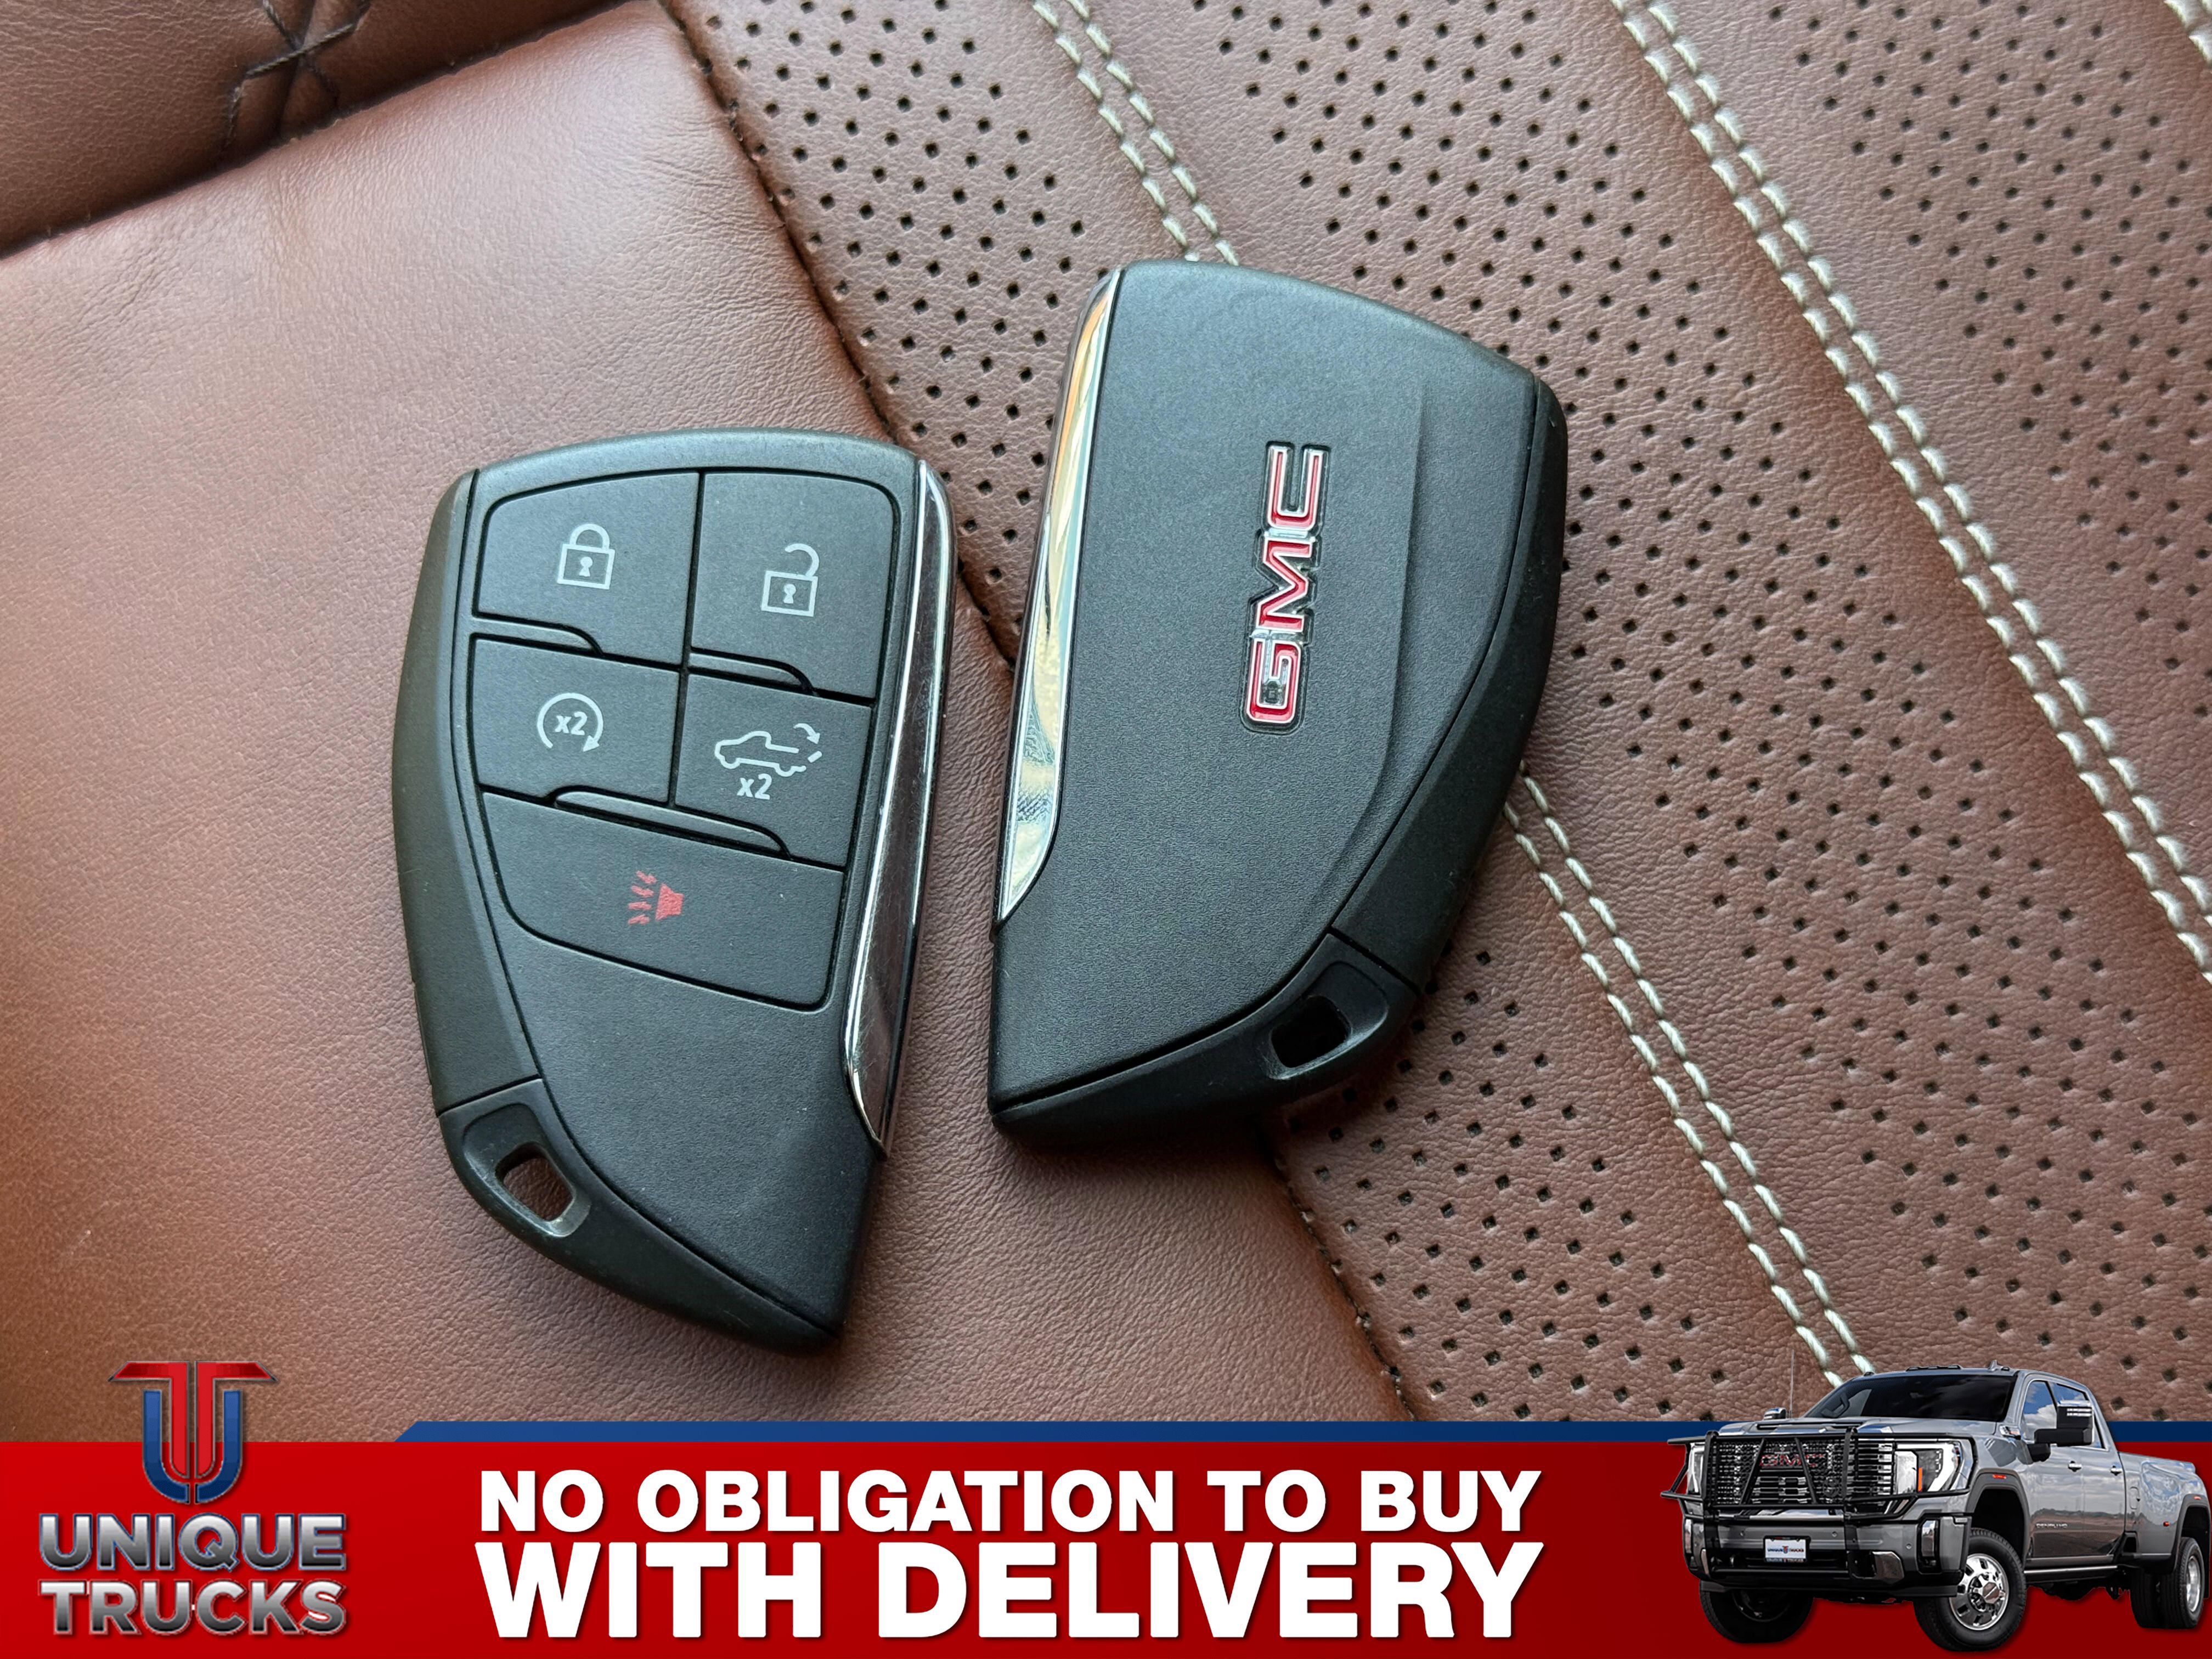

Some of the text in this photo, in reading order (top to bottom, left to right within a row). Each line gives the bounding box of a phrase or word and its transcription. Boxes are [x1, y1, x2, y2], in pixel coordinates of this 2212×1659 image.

[1245, 445, 1324, 724] GMC
[554, 711, 588, 736] x2
[736, 773, 772, 800] x2
